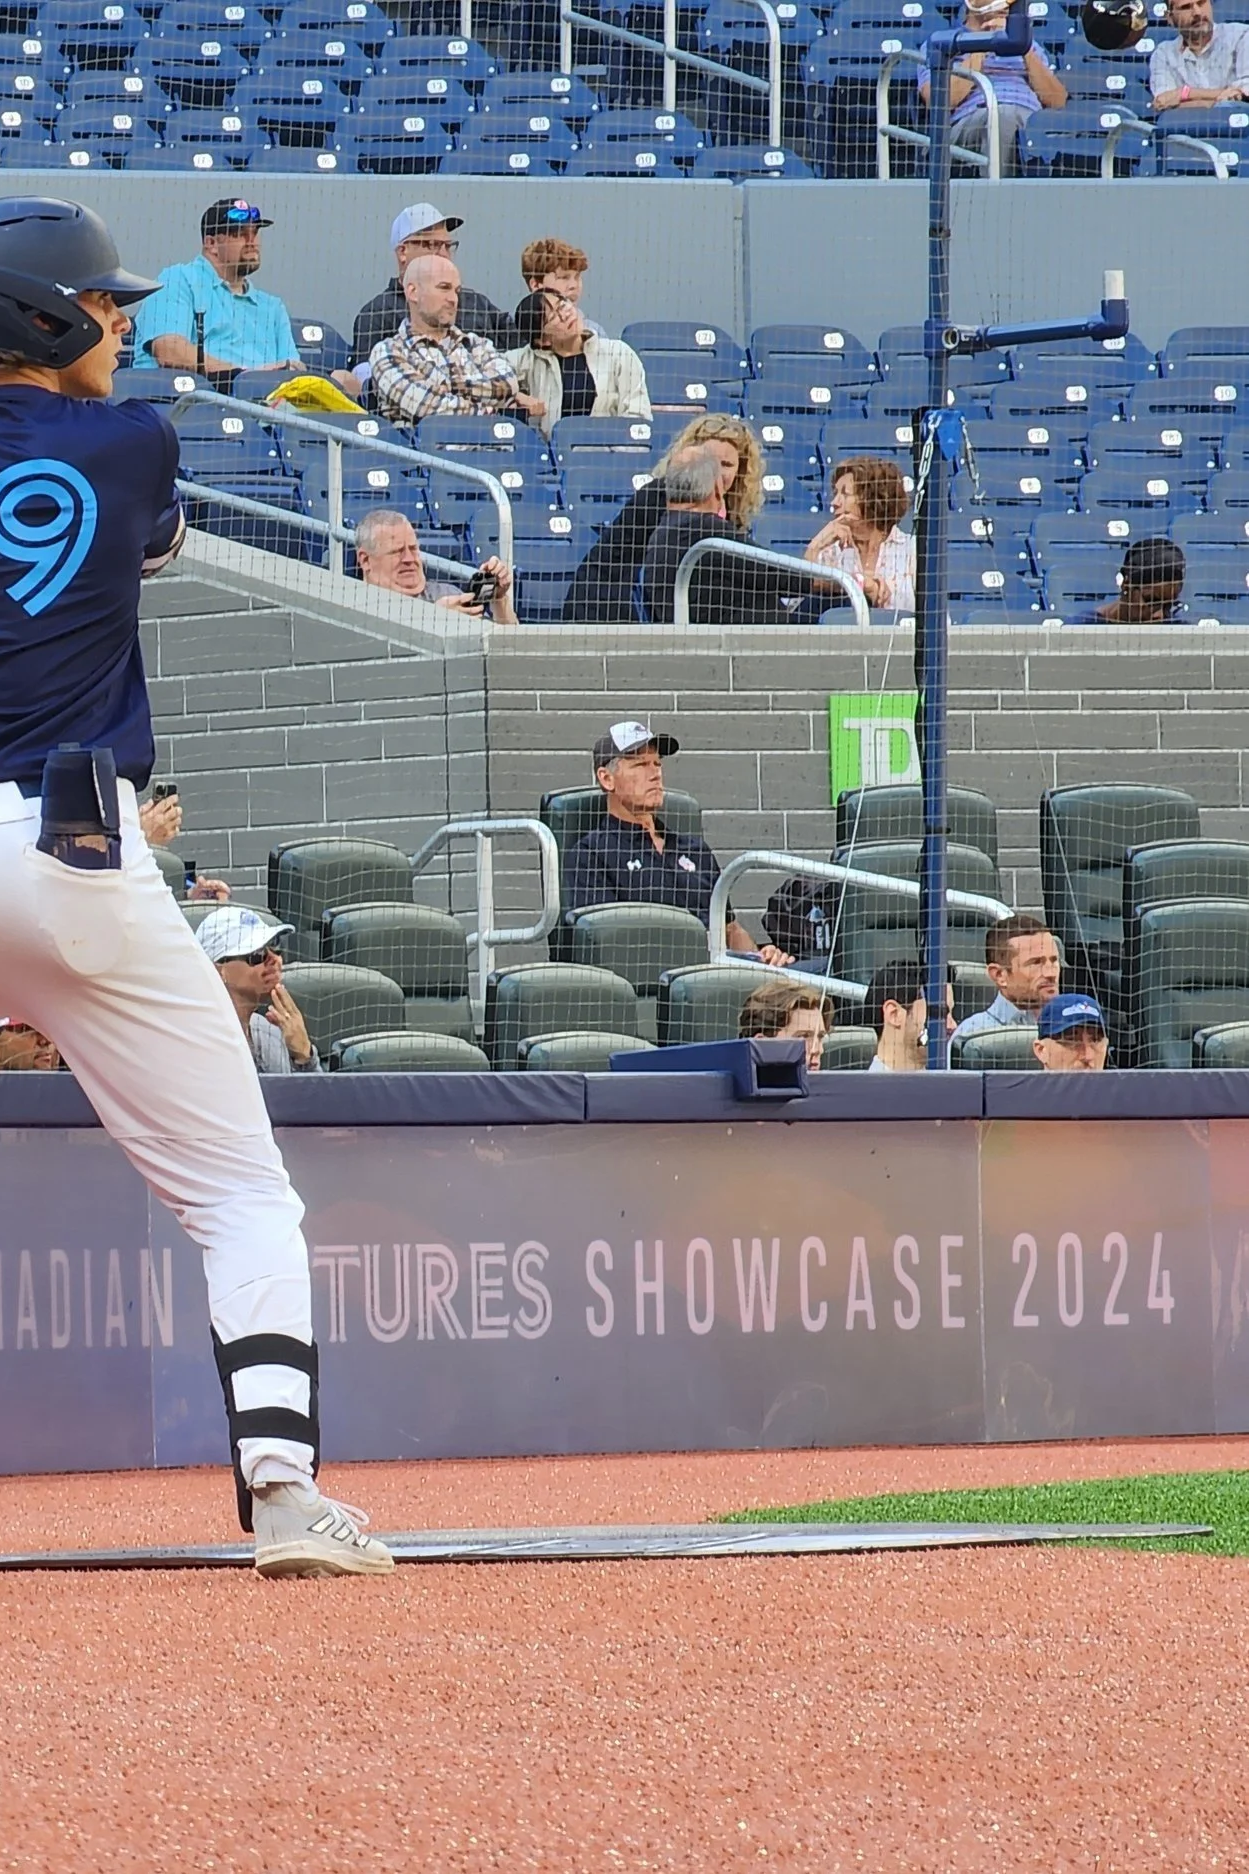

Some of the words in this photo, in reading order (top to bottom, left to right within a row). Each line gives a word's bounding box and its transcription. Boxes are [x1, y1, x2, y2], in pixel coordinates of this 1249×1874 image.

[843, 717, 922, 786] TD
[312, 1240, 553, 1344] TURES
[584, 1235, 966, 1338] SHOWCASE
[1011, 1231, 1175, 1328] 2024
